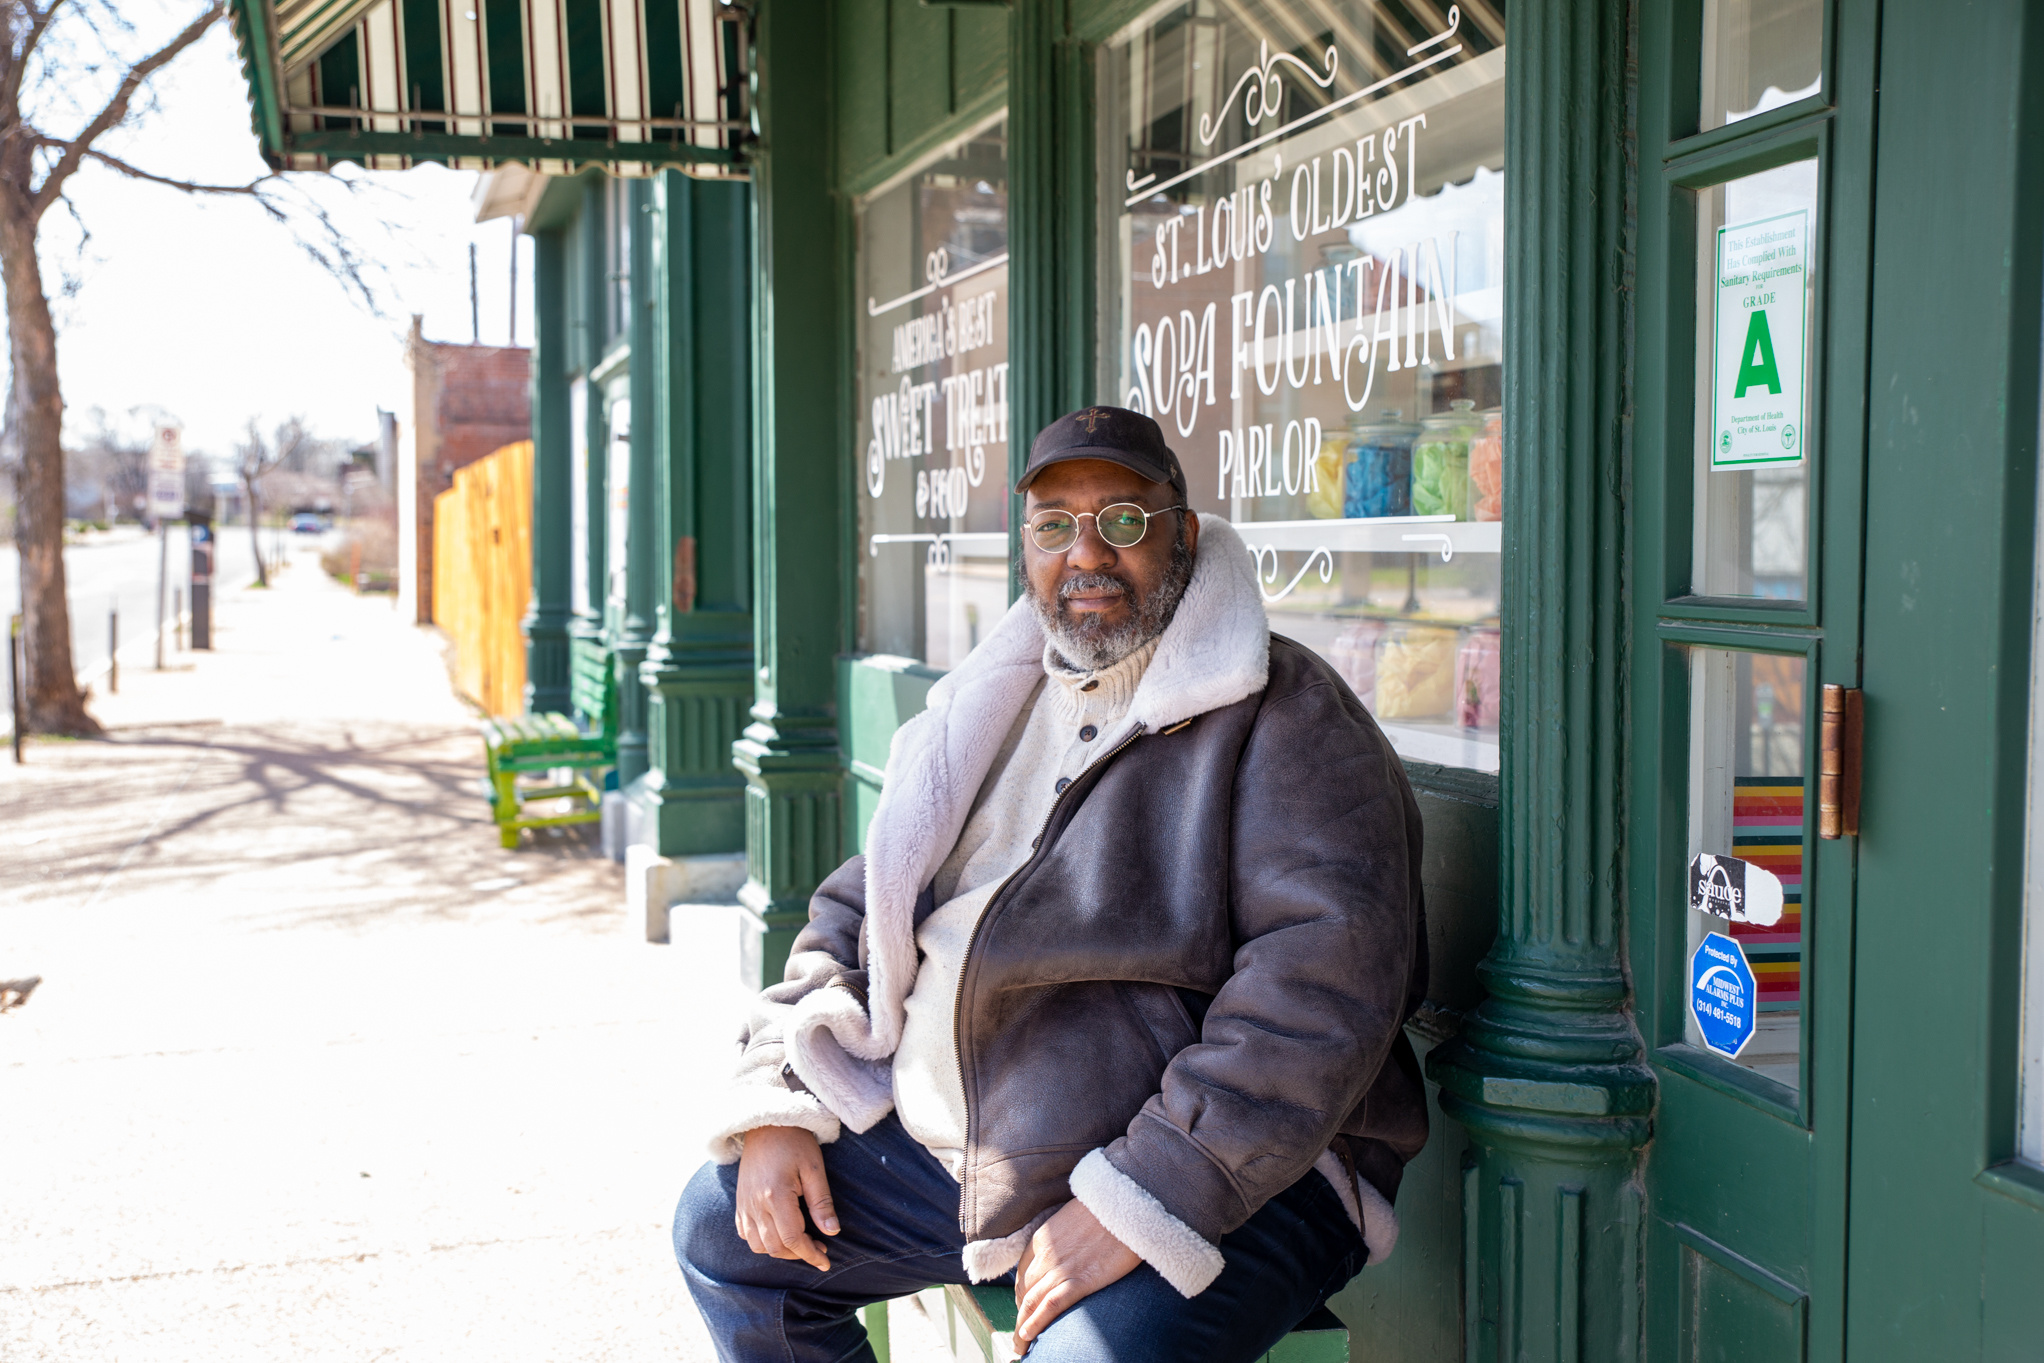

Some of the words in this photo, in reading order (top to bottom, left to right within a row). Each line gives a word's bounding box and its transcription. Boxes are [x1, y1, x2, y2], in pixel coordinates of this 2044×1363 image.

[1290, 113, 1427, 241] OLDEST
[1728, 240, 1743, 252] This
[1745, 228, 1796, 248] Establishment
[1727, 258, 1740, 270] Has
[1742, 249, 1776, 266] Complied
[1778, 245, 1796, 258] With
[1720, 274, 1749, 289] Sanitary
[1752, 263, 1802, 283] Requirements
[1743, 292, 1776, 308] GRADE
[958, 291, 996, 353] BEST
[1124, 302, 1217, 437] SODA
[1230, 230, 1460, 411] FOUNTAIN
[1734, 310, 1782, 398] A
[1731, 414, 1759, 424] Department
[1767, 411, 1784, 420] Health
[1737, 426, 1747, 435] City
[1748, 425, 1754, 433] of
[1762, 424, 1776, 432] Louis
[867, 374, 936, 497] SWEET
[1217, 417, 1322, 500] PARLOR
[930, 467, 968, 519] FOOD
[1698, 879, 1742, 904] sauce
[1705, 944, 1729, 963] Protected
[1730, 955, 1738, 968] By
[1705, 984, 1729, 1003] ALARMS
[1729, 992, 1744, 1009] PLUS
[1713, 976, 1740, 996] MIDWEST
[1696, 998, 1712, 1016] (314)
[1713, 1007, 1741, 1029] 481-5518
